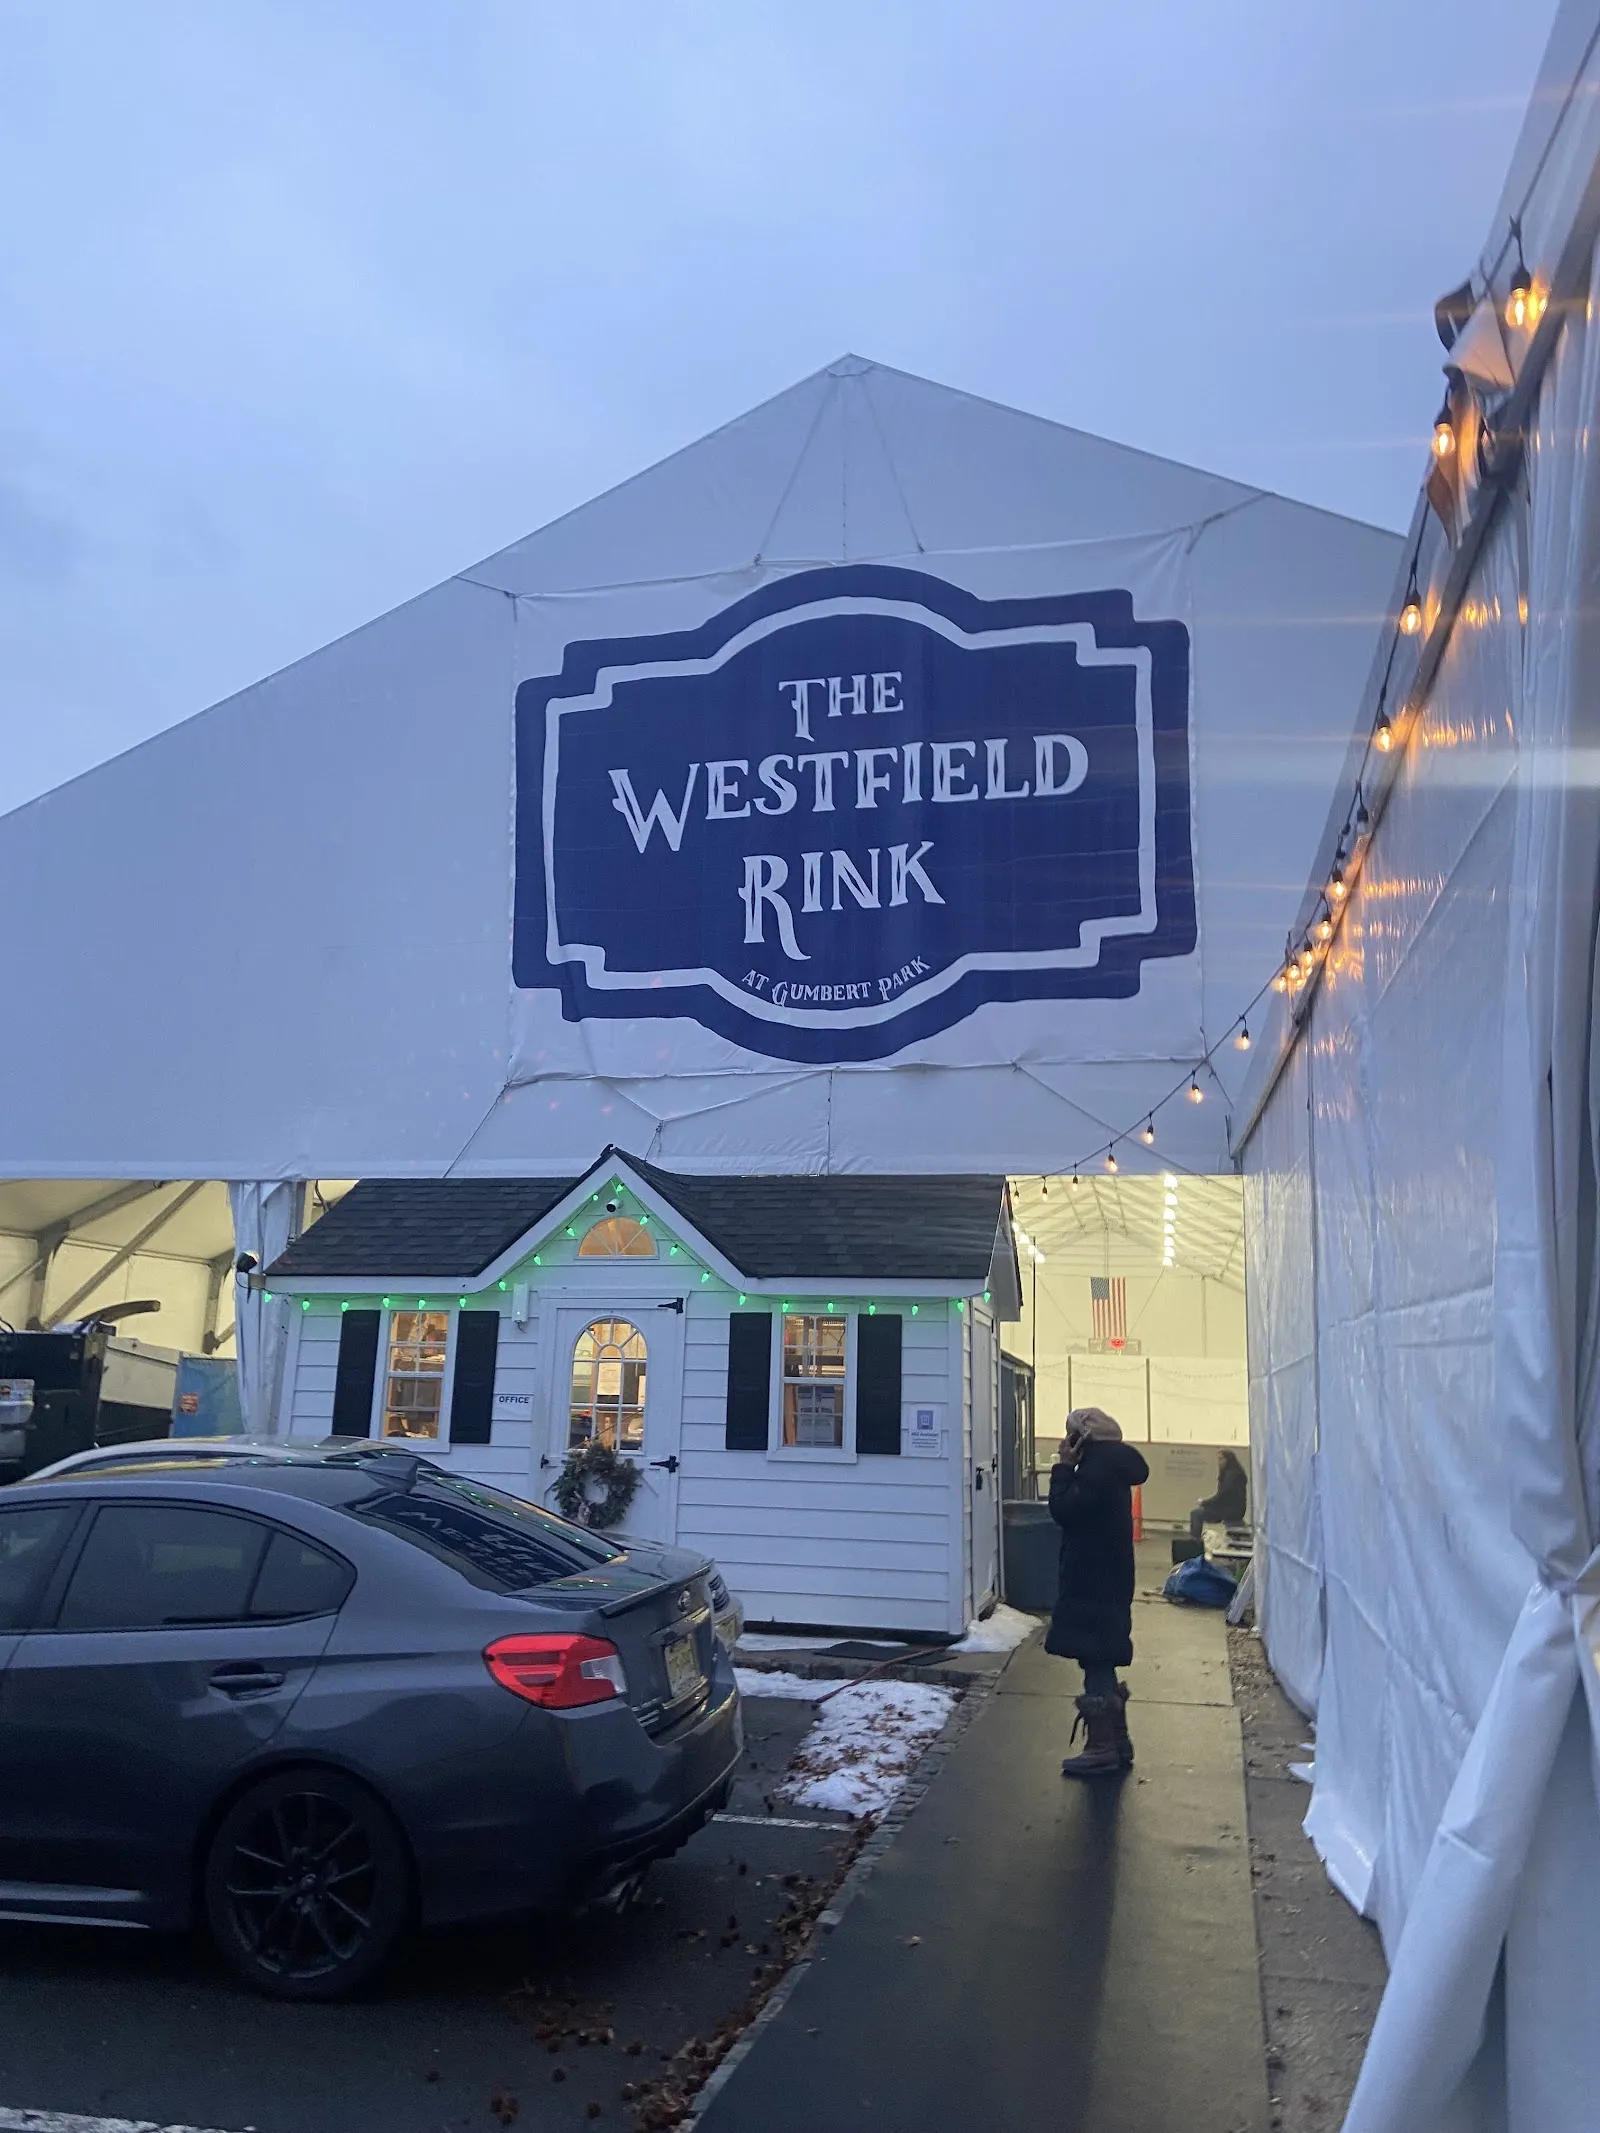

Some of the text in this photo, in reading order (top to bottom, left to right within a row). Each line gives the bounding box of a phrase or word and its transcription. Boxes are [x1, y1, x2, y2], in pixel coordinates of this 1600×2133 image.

[778, 671, 904, 743] THE
[607, 734, 1089, 854] WESTFIELD
[737, 840, 946, 961] RINK
[742, 956, 931, 1007] AT GUMBERT PARK
[498, 1395, 530, 1404] OFFICE
